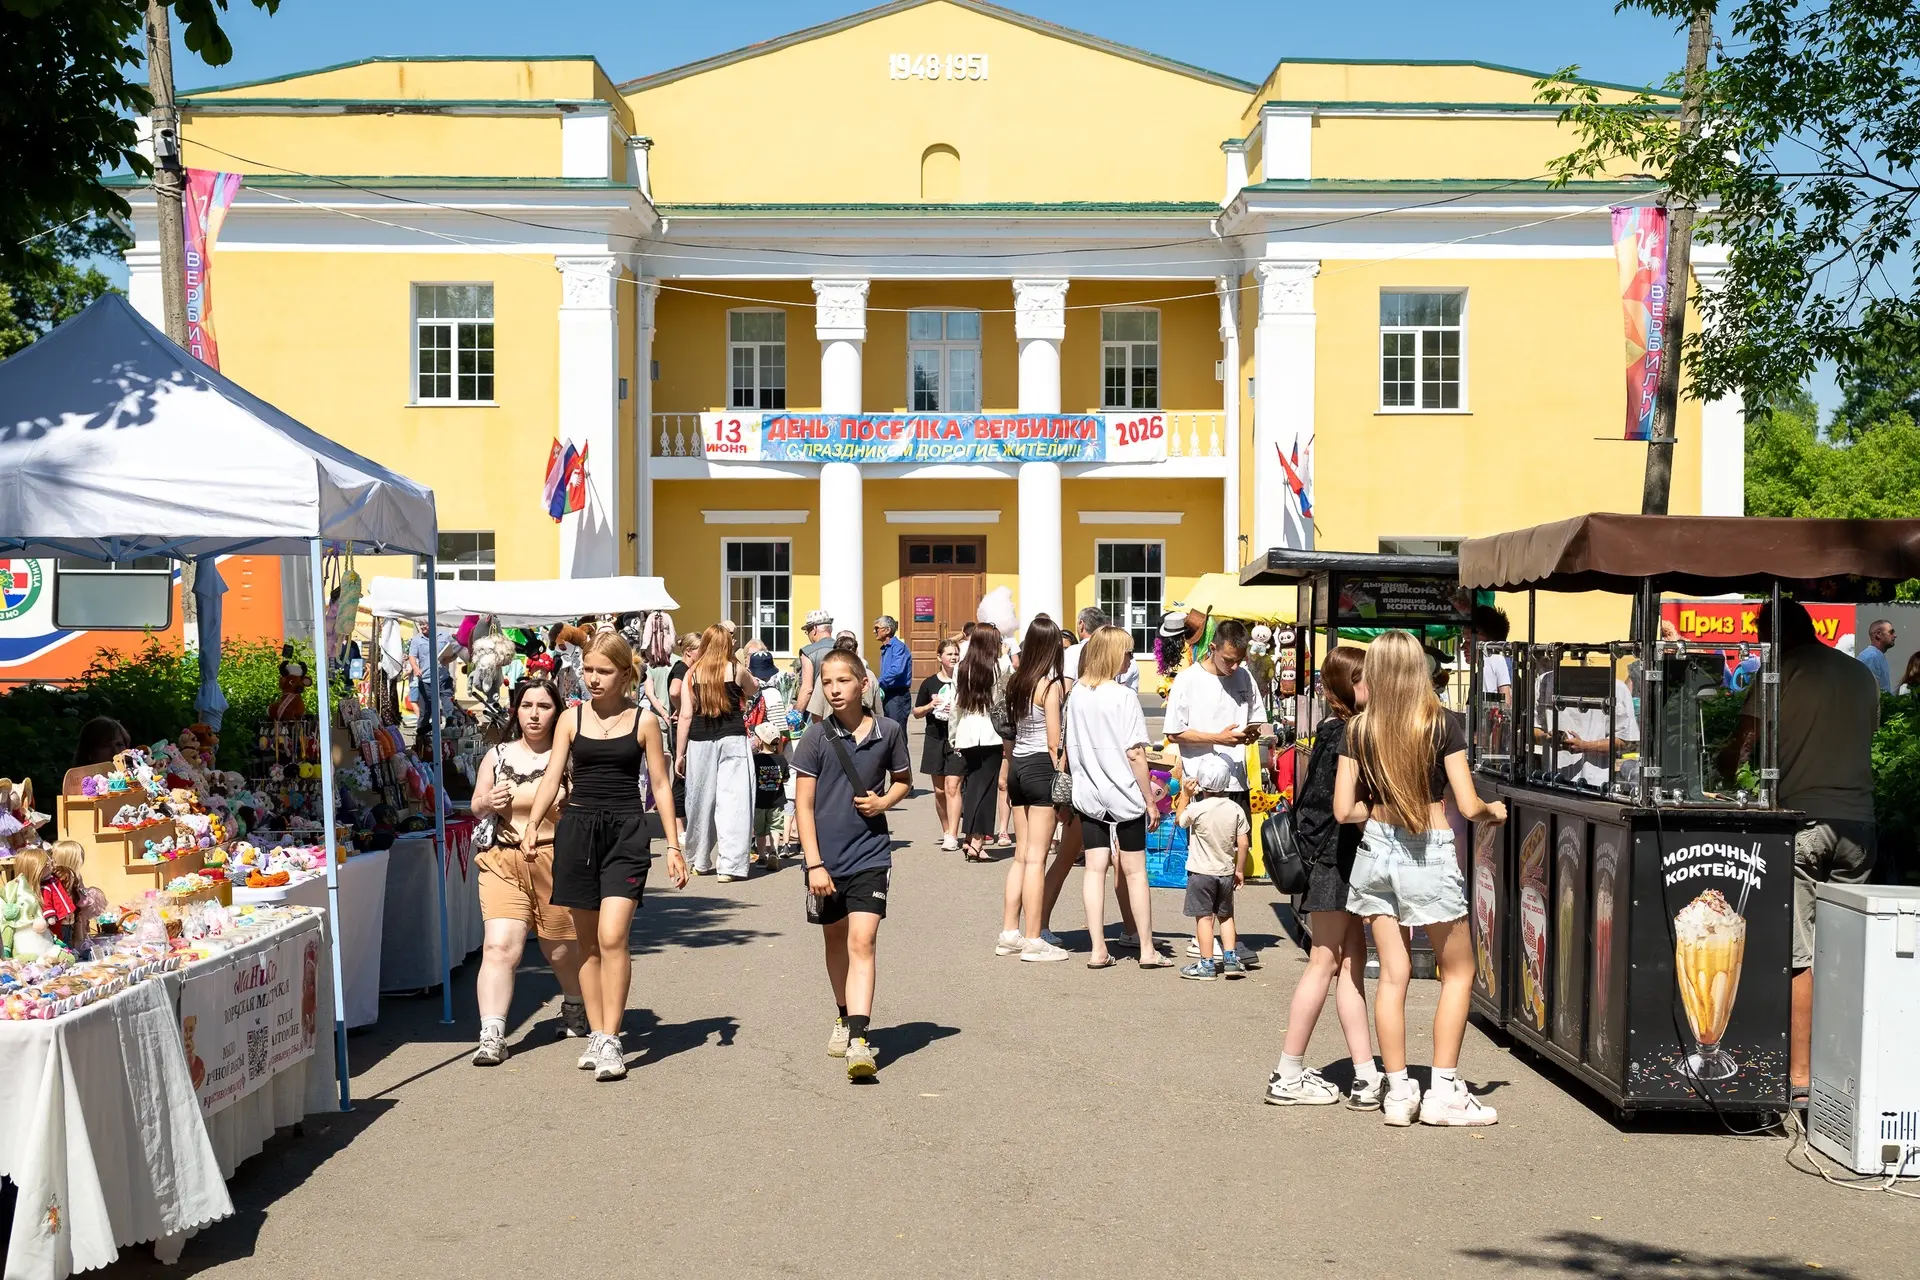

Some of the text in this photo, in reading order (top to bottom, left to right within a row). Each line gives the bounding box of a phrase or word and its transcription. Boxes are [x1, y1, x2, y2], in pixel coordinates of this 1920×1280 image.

[714, 418, 742, 443] 13
[767, 418, 830, 441] ДЕНЬ
[974, 417, 1098, 441] ВЕРБИЛКИ
[1115, 415, 1164, 447] 2026
[706, 443, 747, 454] ИЮНЯ
[786, 443, 799, 457] С
[916, 443, 998, 460] ДОРОГИЕ
[1002, 442, 1081, 457] ЖИТЕЛИ!!!
[1679, 610, 1735, 637] Приз
[1663, 843, 1767, 874] МОЛОЧНЫЕ
[1665, 860, 1761, 890] КОКТЕЙЛИ
